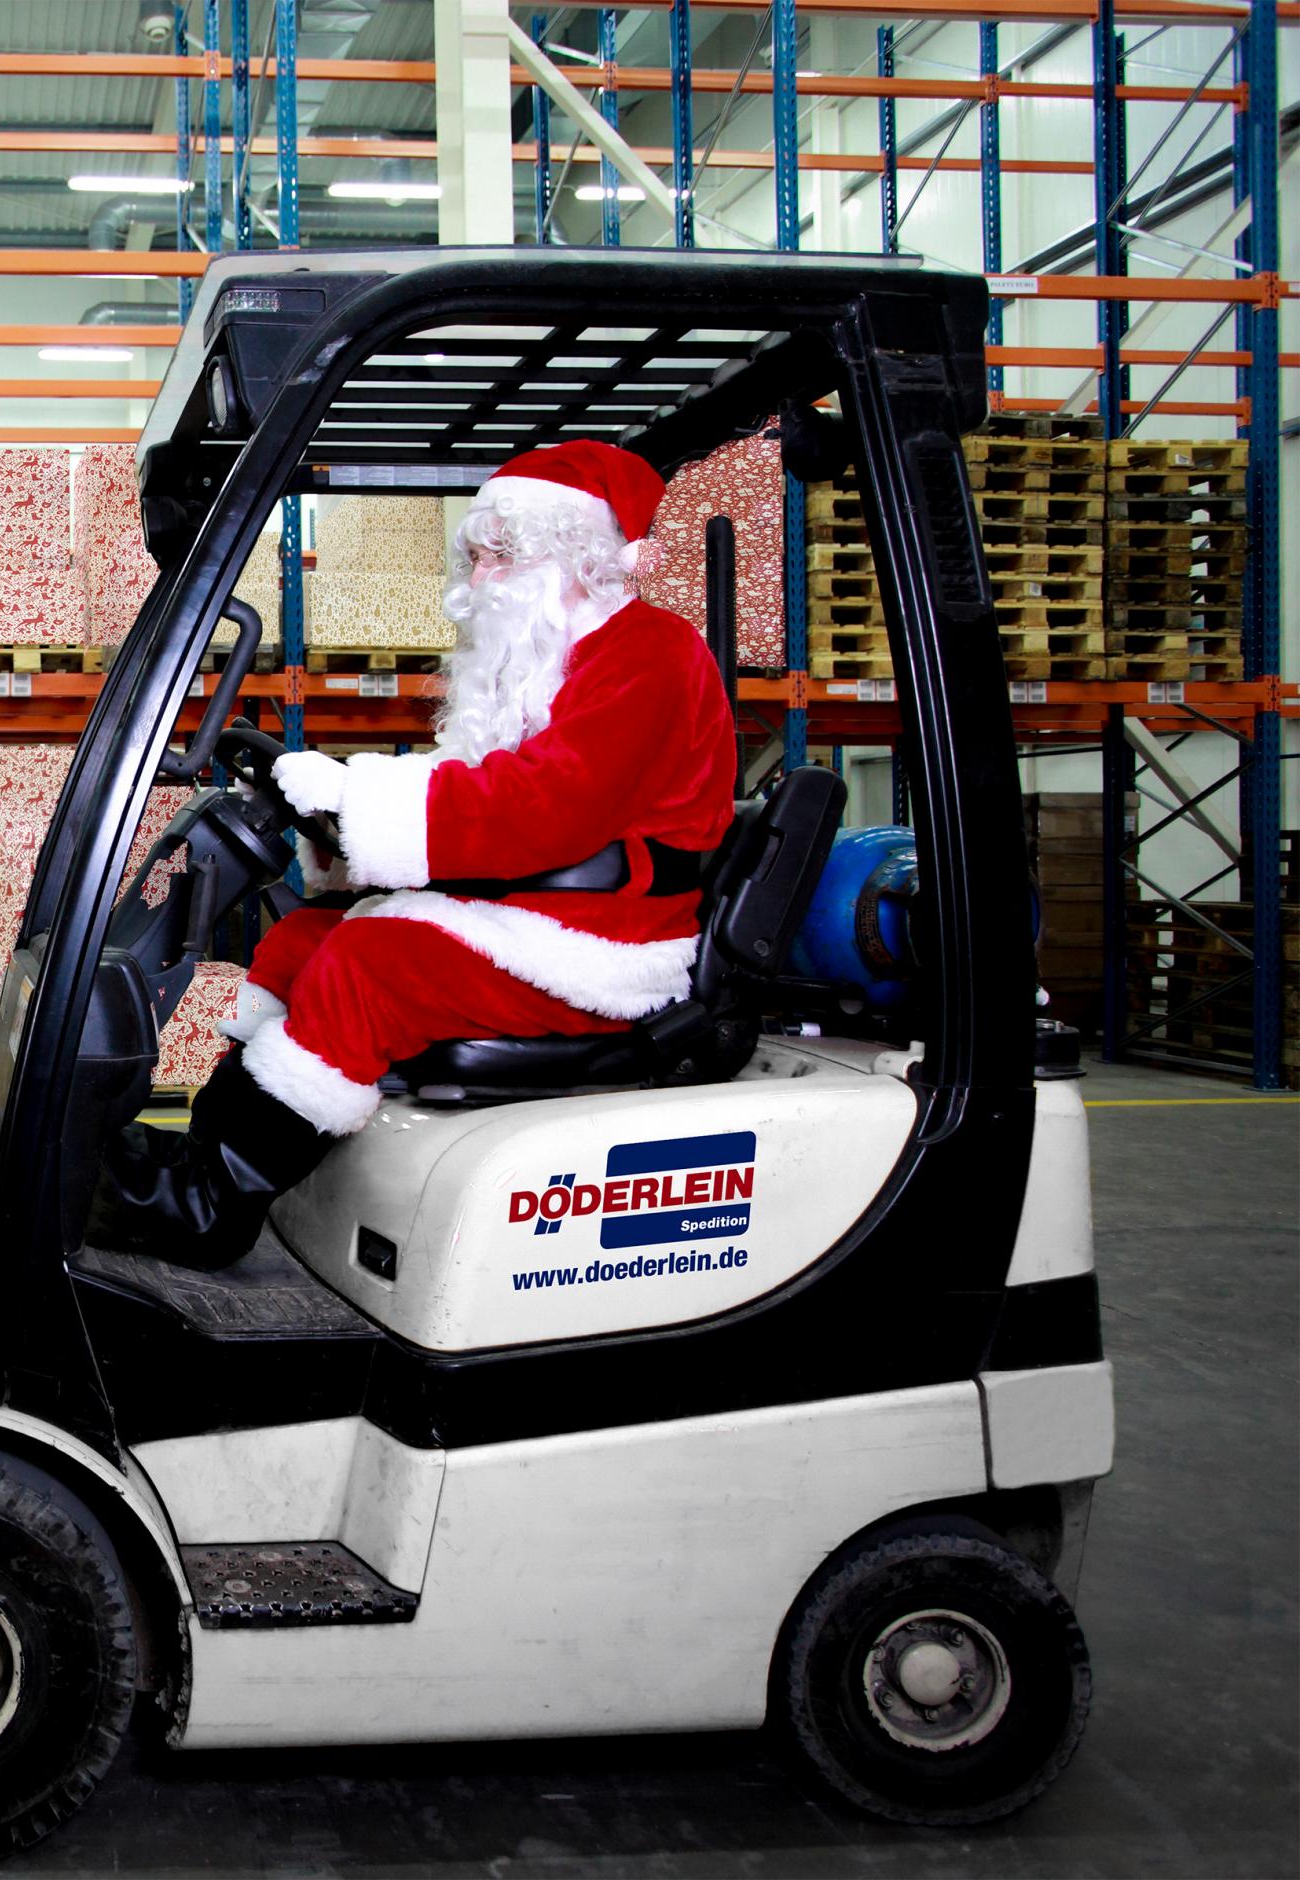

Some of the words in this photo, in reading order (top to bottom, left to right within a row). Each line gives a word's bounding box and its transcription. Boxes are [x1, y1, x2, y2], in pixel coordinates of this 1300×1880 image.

[508, 1167, 755, 1224] DÖDERLEIN
[680, 1215, 748, 1234] Spedition
[512, 1246, 749, 1291] www.doederlein.de
